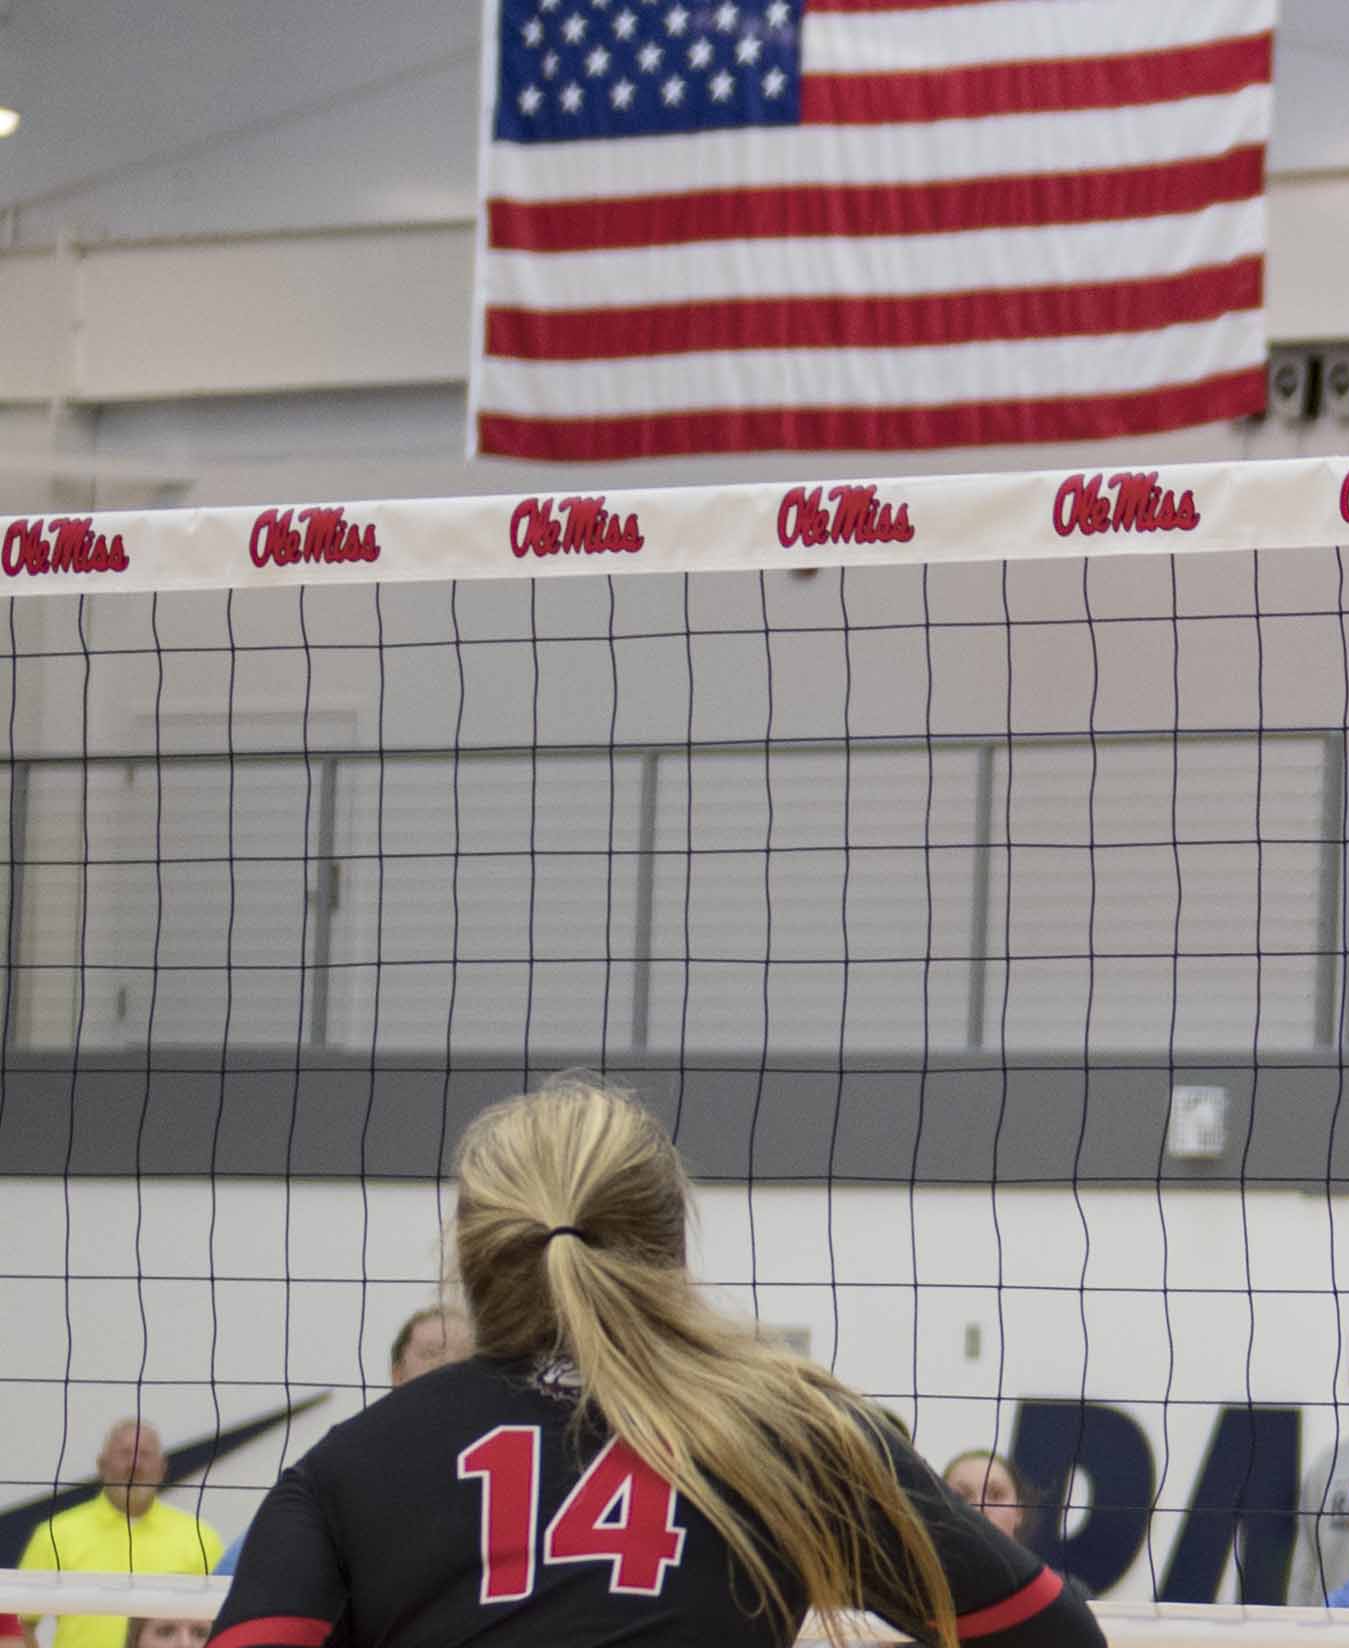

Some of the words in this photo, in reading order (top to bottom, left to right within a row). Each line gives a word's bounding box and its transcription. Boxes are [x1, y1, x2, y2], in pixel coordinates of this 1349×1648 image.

[509, 499, 560, 558] Ole
[560, 497, 644, 555] Miss
[777, 487, 830, 549] Ole
[830, 485, 916, 546] Miss
[1052, 475, 1108, 536] Ole
[1108, 473, 1200, 533] Miss
[2, 521, 50, 576] Ole
[50, 519, 128, 574] Miss
[250, 510, 299, 568] Ole
[299, 508, 380, 566] Miss
[457, 1425, 687, 1604] 14
